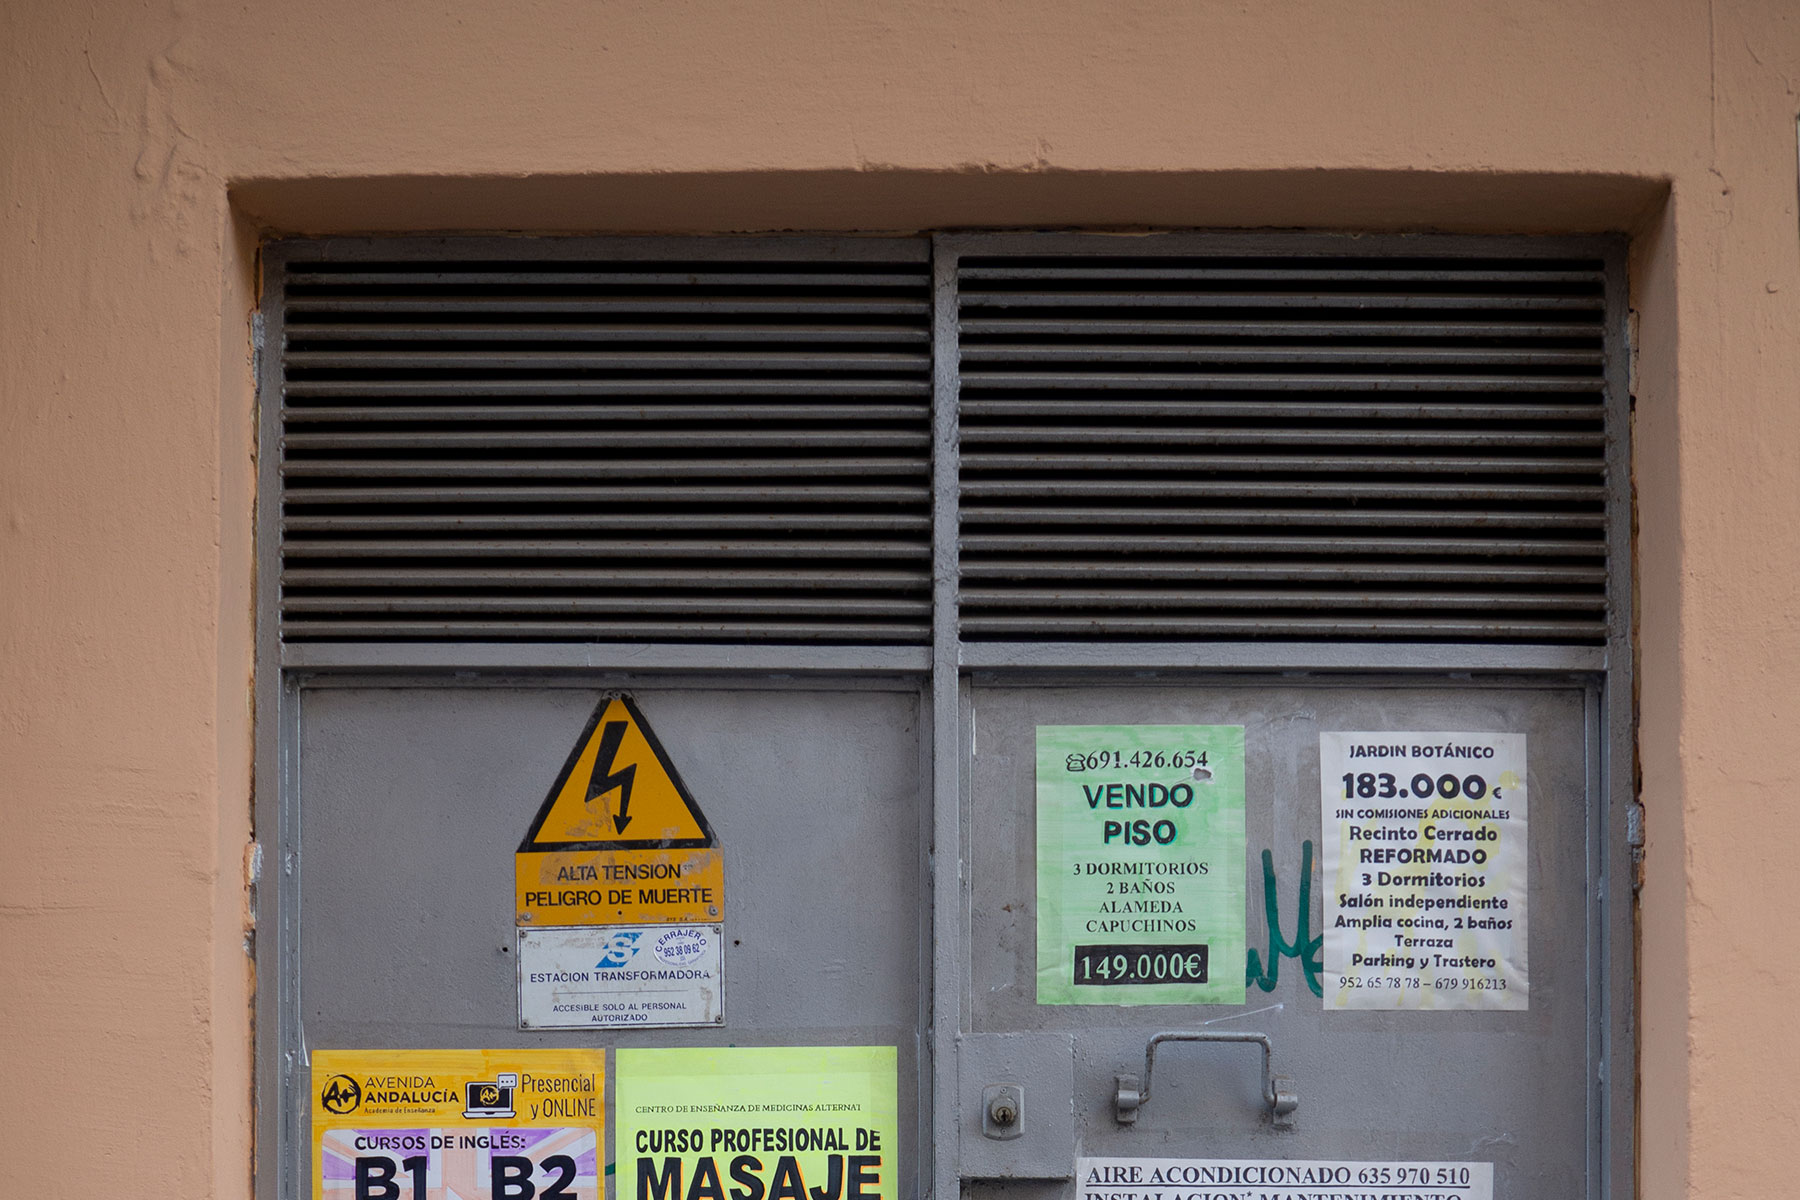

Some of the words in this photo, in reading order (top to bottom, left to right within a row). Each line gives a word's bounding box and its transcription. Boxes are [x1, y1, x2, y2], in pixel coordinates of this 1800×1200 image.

[1350, 745, 1406, 758] JARDIN
[1411, 743, 1494, 759] BOTÁNICO
[1342, 772, 1487, 800] 183.000
[1082, 783, 1194, 809] VENDO
[1336, 809, 1354, 819] SIN
[1357, 809, 1428, 819] COMISIONES
[1431, 809, 1510, 820] ADICIONALES
[1103, 819, 1177, 845] PISO
[1350, 826, 1417, 841] Recinto
[1424, 825, 1497, 841] Cerrado
[1360, 849, 1487, 864] REFORMADO
[557, 865, 598, 881] ALTA
[602, 864, 681, 880] TENSION
[1086, 862, 1209, 876] DORMITORIOS
[1120, 879, 1175, 894] BAÑOS
[1362, 874, 1371, 886] 3
[1378, 872, 1485, 887] Dormitorios
[525, 890, 601, 907] PELIGRO
[609, 889, 632, 905] DE
[639, 888, 712, 904] MUERTE
[1339, 894, 1384, 908] Salón
[1389, 894, 1508, 910] independiente
[1099, 901, 1183, 913] ALAMEDA
[1086, 920, 1196, 933] CAPUCHINOS
[1335, 915, 1392, 930] Amplia
[1397, 917, 1449, 930] cocina,
[1468, 916, 1512, 930] baños
[1394, 934, 1453, 948] Terraza
[1082, 954, 1201, 980] 149.000€
[1352, 953, 1415, 968] Parking
[1433, 954, 1496, 968] Trastero
[530, 972, 589, 983] ESTACION
[595, 969, 710, 982] TRANSFORMADORA
[1339, 977, 1363, 989] 952
[1368, 977, 1382, 989] 65
[1386, 977, 1400, 989] 78
[1405, 977, 1420, 989] 78
[1435, 977, 1458, 989] 679
[1462, 978, 1506, 990] 916213
[553, 1003, 599, 1013] ACCESIBLE
[602, 1003, 625, 1012] SOLO
[628, 1002, 639, 1011] AL
[641, 1001, 686, 1011] PERSONAL
[591, 1013, 648, 1022] AUTORIZADO
[365, 1076, 435, 1088] AVENIDA
[522, 1074, 596, 1093] Presencial
[365, 1089, 459, 1103] ANDALUCÍA
[543, 1099, 596, 1117] ONLINE
[636, 1105, 674, 1113] CENTRO
[675, 1105, 689, 1113] DE
[690, 1103, 746, 1113] ENSEÑANZA
[747, 1104, 761, 1112] DE
[762, 1103, 814, 1112] MEDICINAS
[354, 1136, 426, 1150] CURSOS
[431, 1136, 454, 1149] DE
[636, 1128, 704, 1153] CURSO
[711, 1128, 849, 1152] PROFESIONAL
[855, 1128, 881, 1151] DE
[1087, 1166, 1143, 1185] AIRE
[1149, 1166, 1351, 1185] ACONDICIONADO
[1358, 1168, 1392, 1185] 635
[1397, 1168, 1431, 1185] 970
[1437, 1168, 1471, 1185] 510
